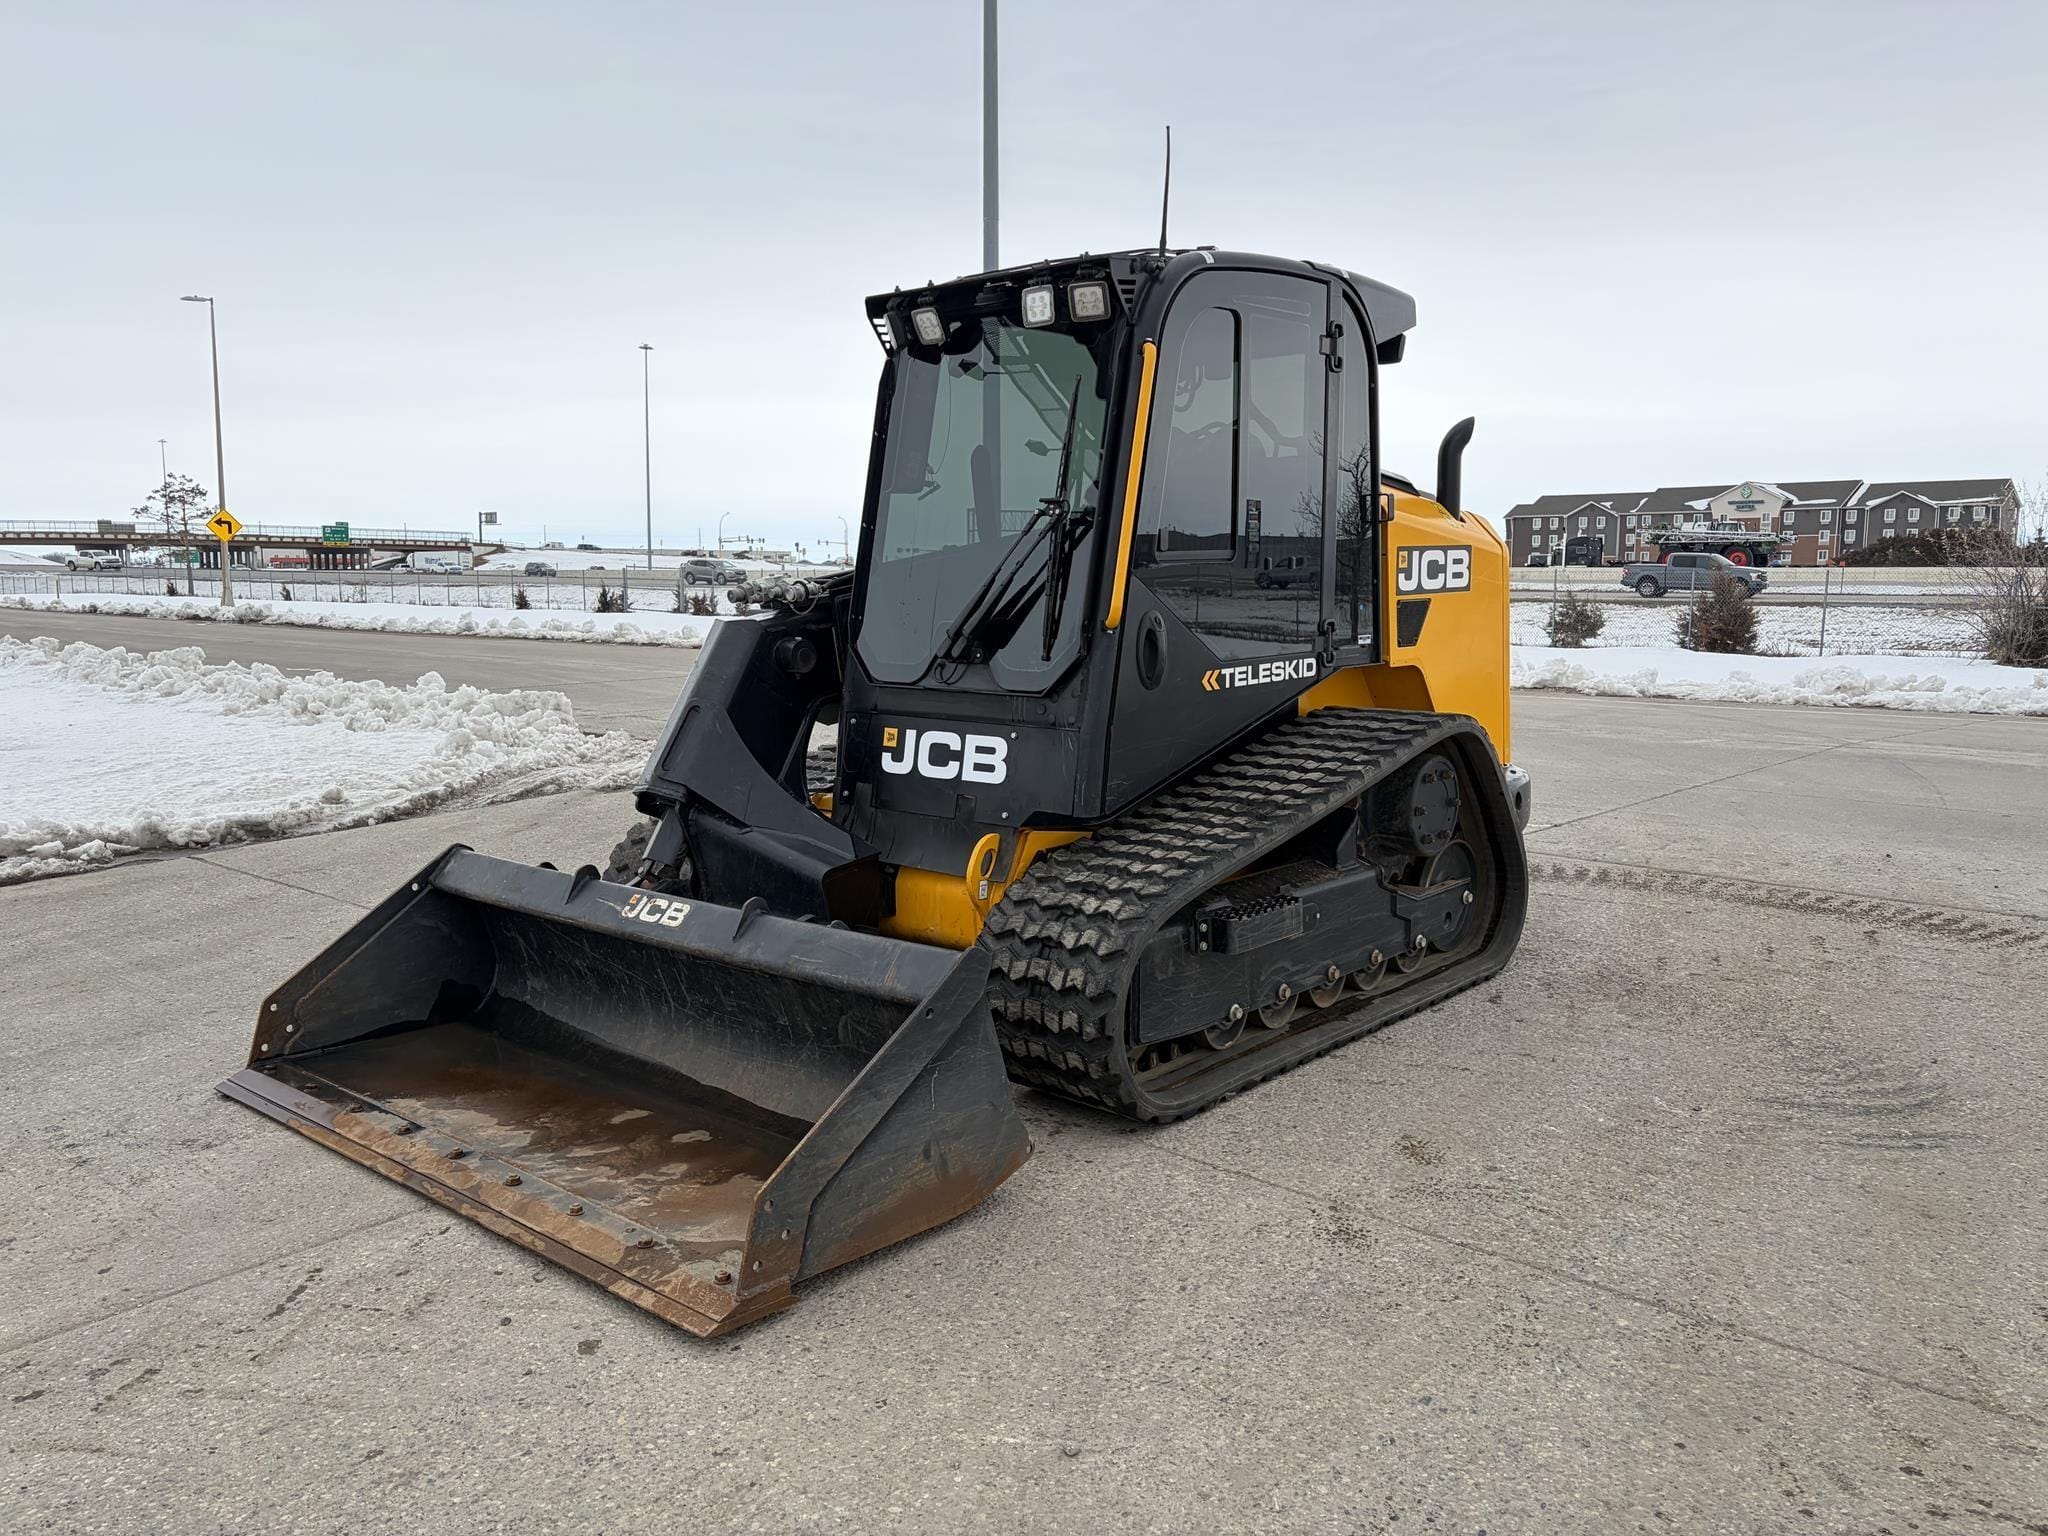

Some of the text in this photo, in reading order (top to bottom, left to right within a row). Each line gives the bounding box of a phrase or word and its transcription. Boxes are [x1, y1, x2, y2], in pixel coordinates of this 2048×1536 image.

[1398, 550, 1470, 591] JCB
[1221, 658, 1317, 689] TELESKID
[881, 728, 1008, 784] JCB
[621, 895, 691, 927] JCB
